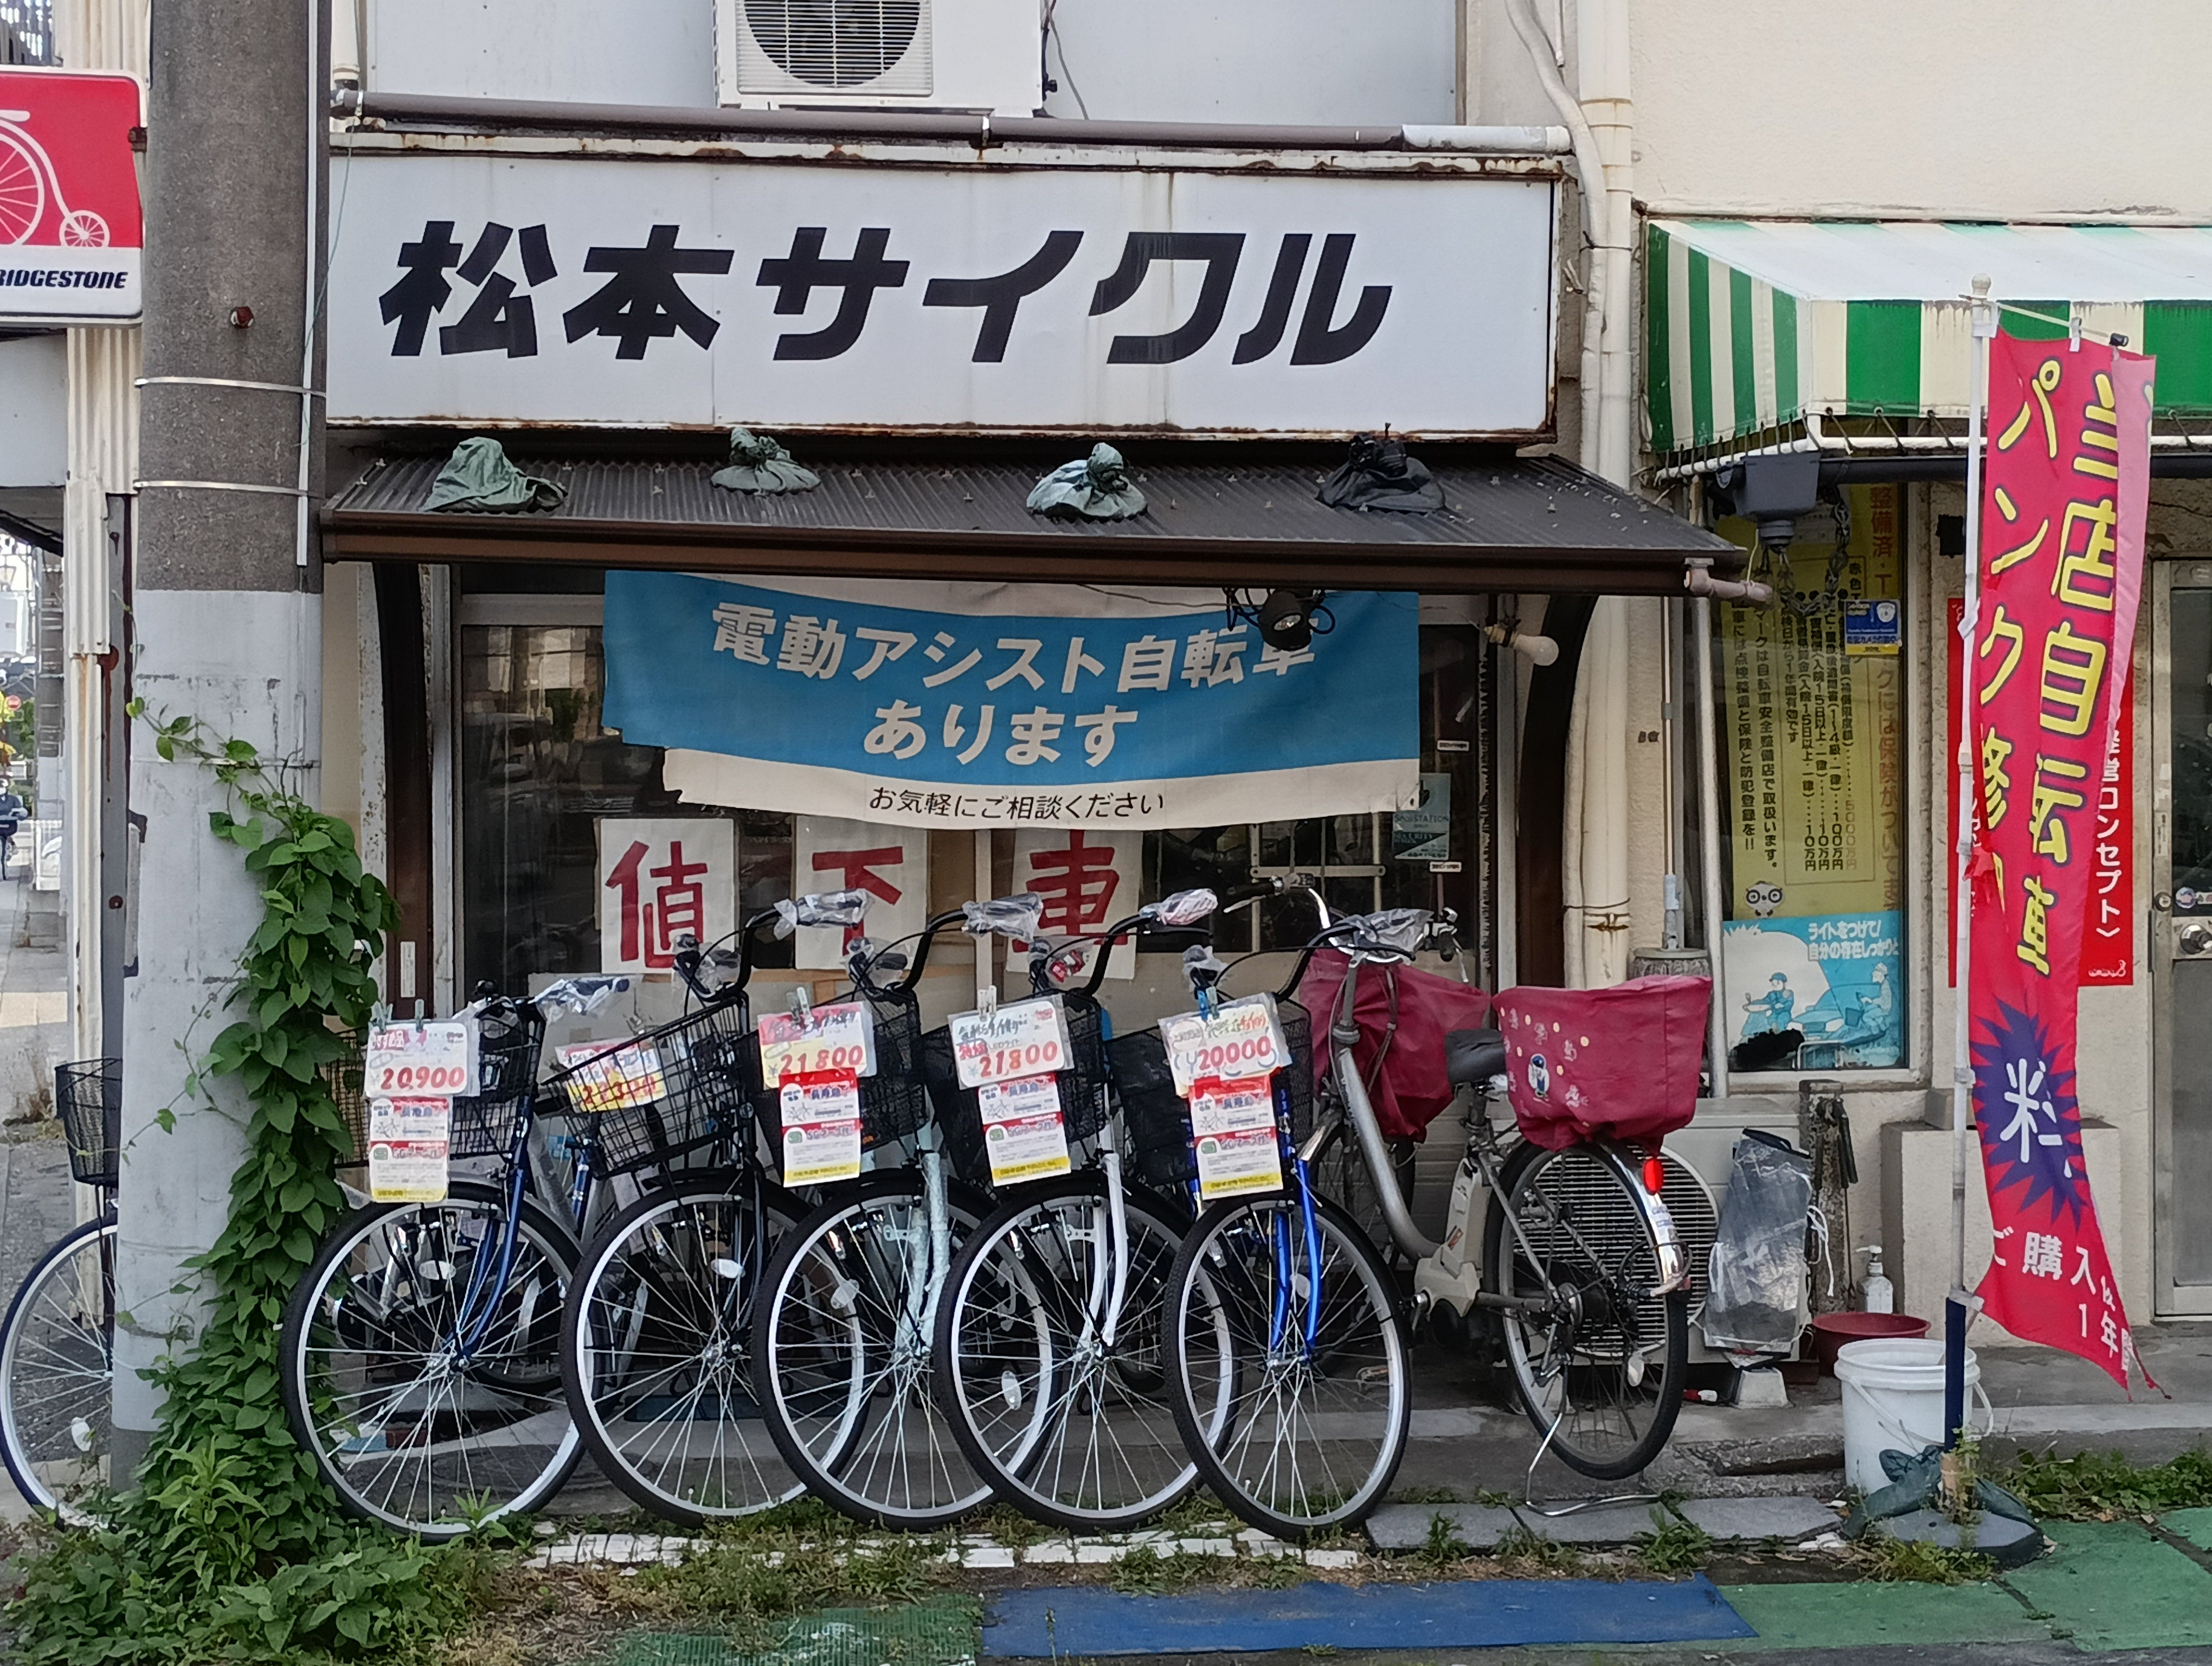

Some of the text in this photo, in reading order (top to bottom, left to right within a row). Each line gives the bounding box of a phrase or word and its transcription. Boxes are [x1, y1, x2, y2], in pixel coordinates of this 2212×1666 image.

[379, 221, 1393, 366] 松本サイクル
[864, 700, 1138, 767] あります
[869, 787, 1164, 820] お気軽にご相談ください
[605, 841, 708, 968] 値
[812, 845, 903, 956] 下
